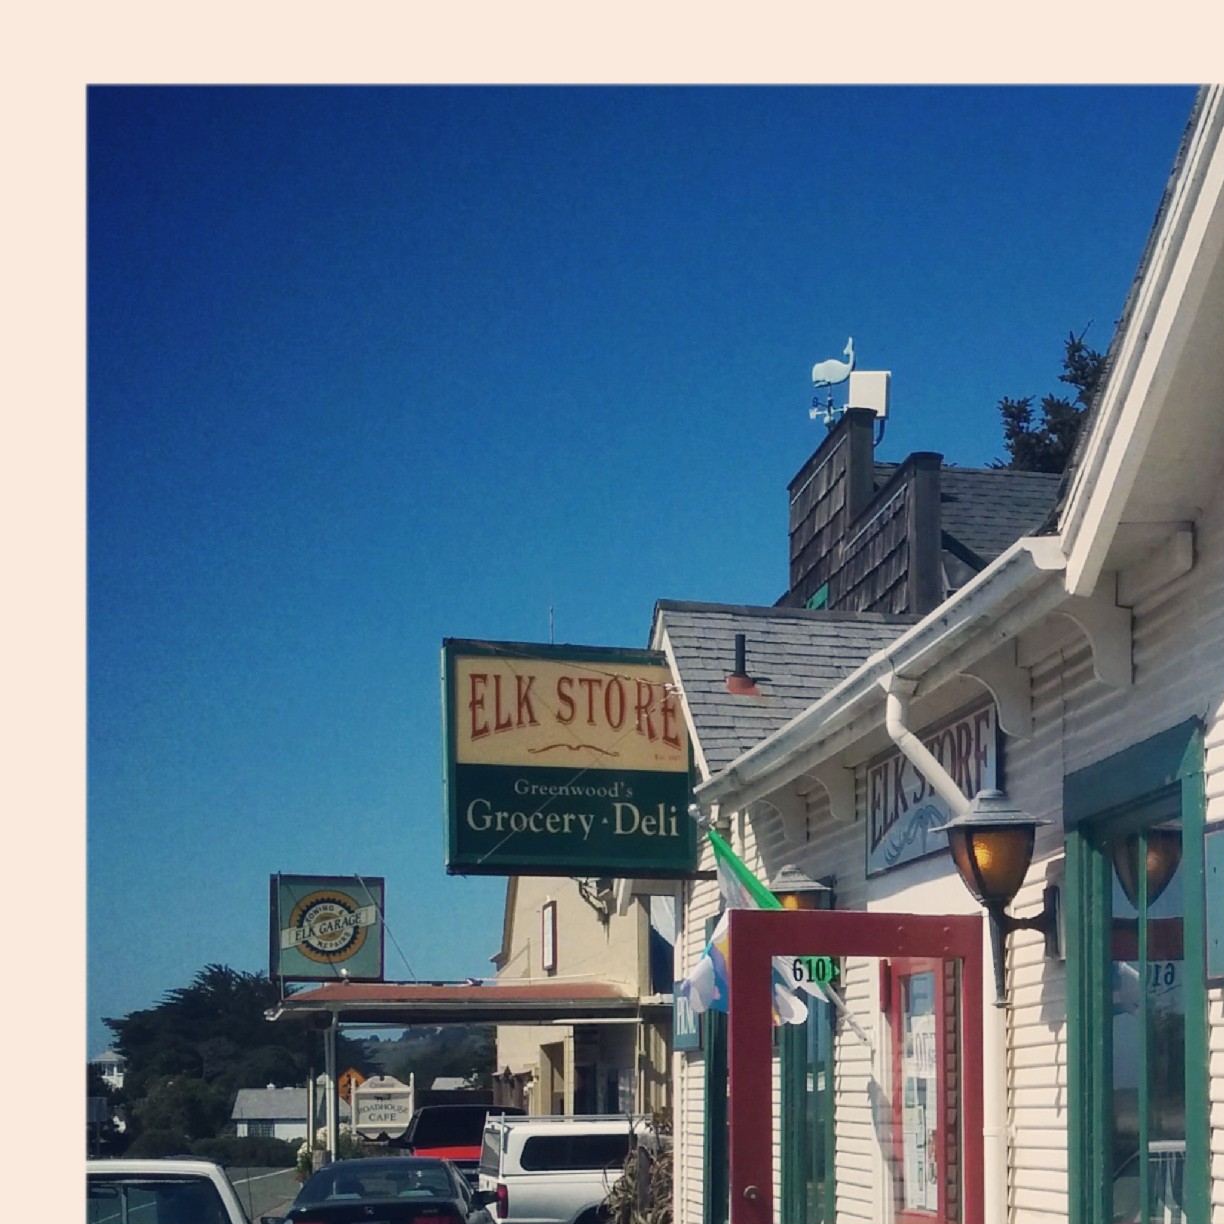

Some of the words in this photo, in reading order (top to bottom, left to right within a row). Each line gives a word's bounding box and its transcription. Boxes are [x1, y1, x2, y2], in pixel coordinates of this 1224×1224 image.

[469, 673, 540, 741] ELK
[556, 675, 682, 750] STORE
[514, 779, 633, 797] Greenwood's
[871, 752, 908, 854] ELK
[467, 799, 595, 840] Grocery
[613, 803, 680, 836] Deli
[295, 926, 316, 941] ELK
[319, 913, 361, 934] GARAGE
[368, 1113, 397, 1121] CAFE
